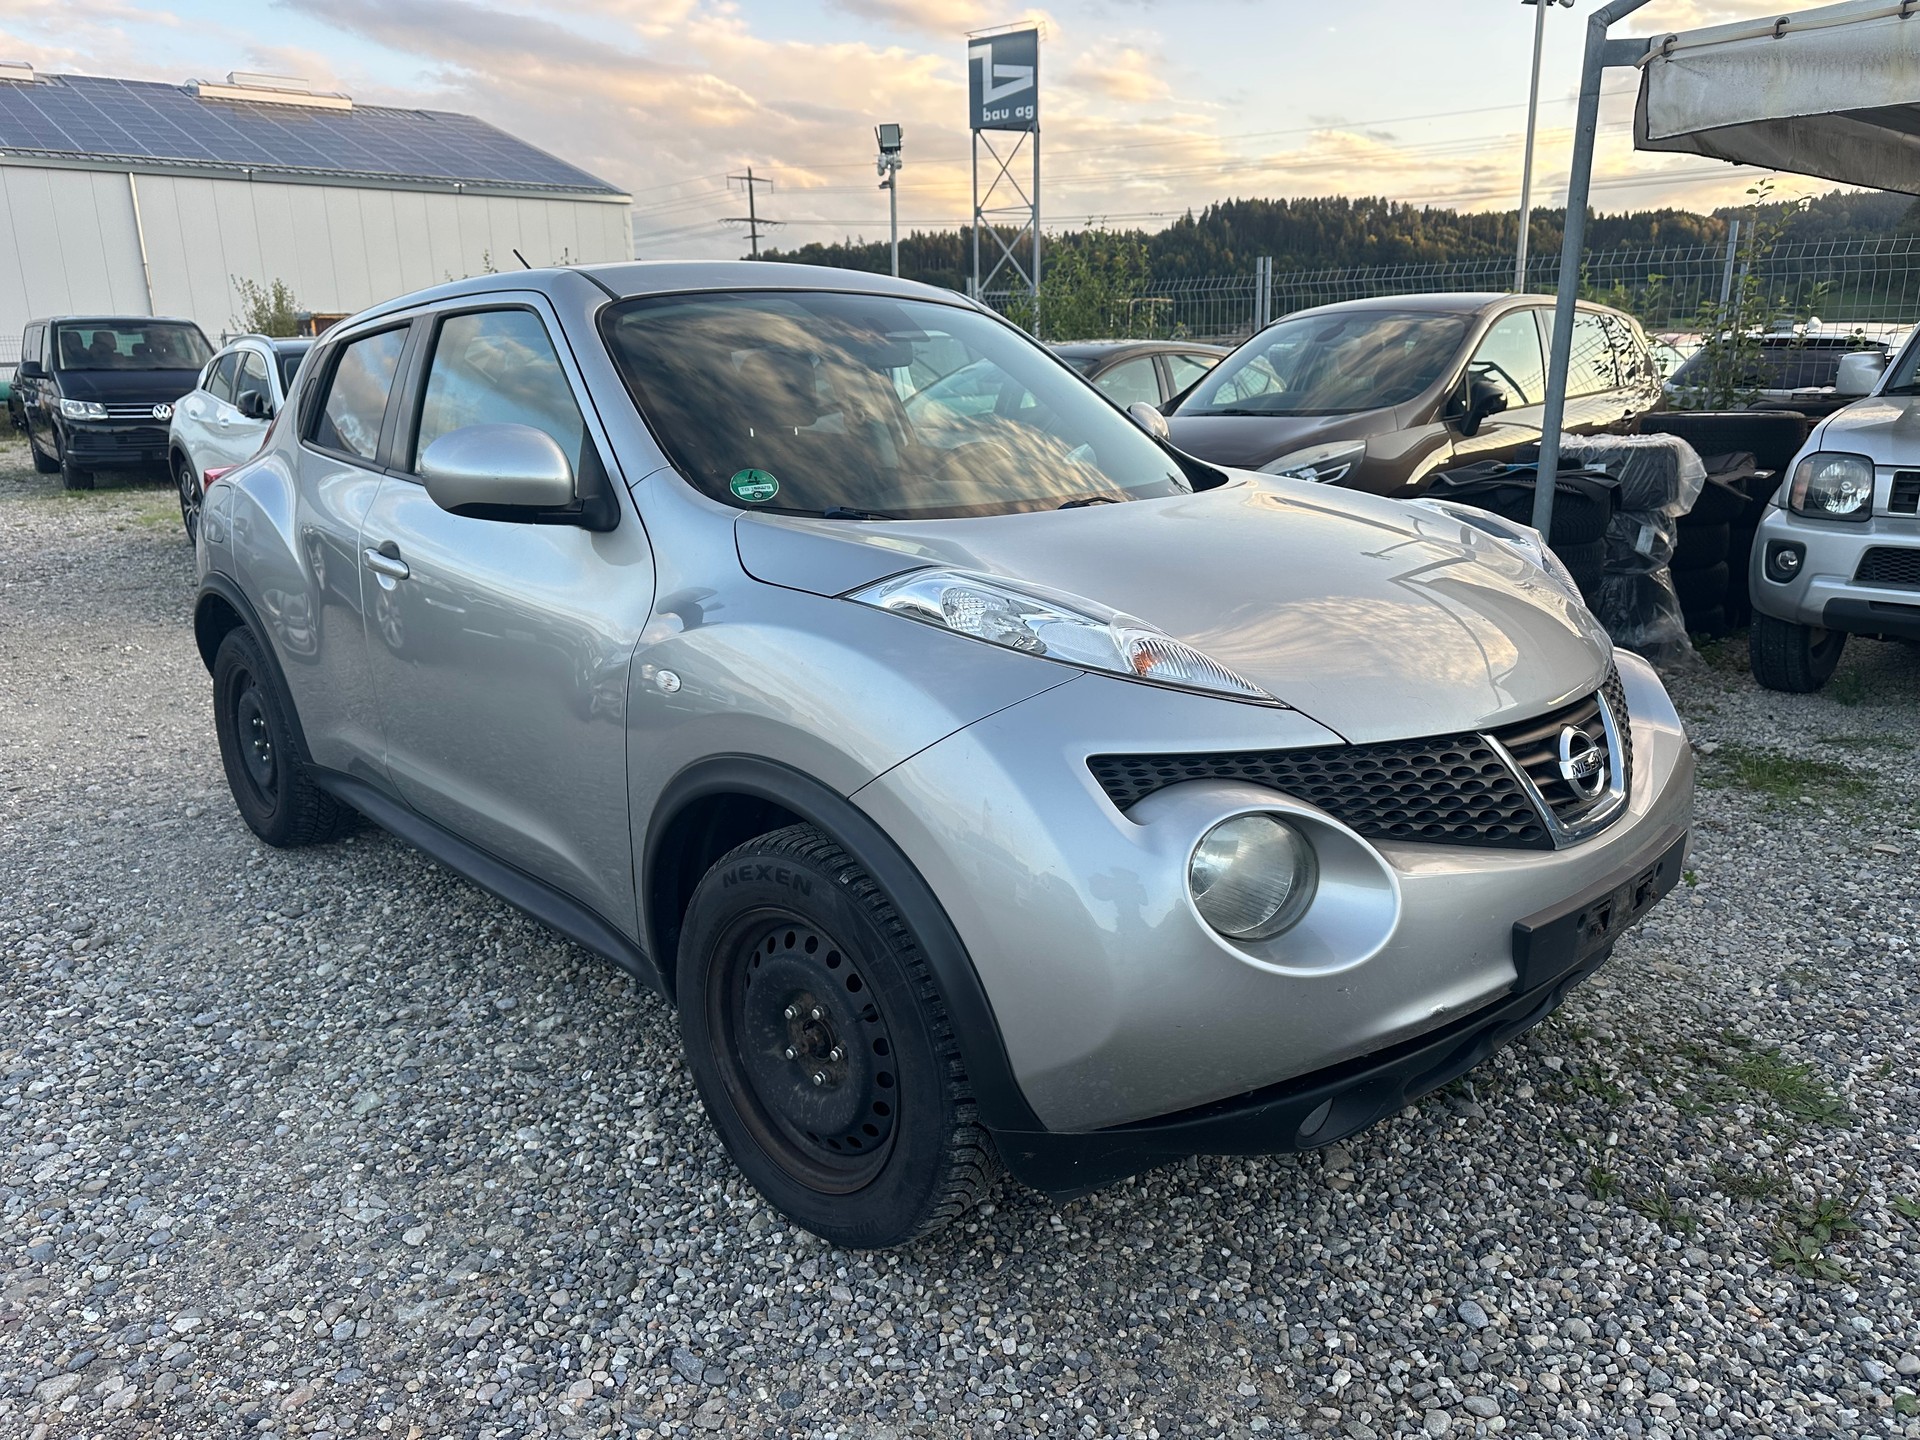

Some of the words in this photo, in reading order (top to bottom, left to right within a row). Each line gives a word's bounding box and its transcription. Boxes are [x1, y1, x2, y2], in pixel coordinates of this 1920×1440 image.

[983, 107, 1010, 122] bau
[1015, 105, 1034, 119] ag
[1571, 754, 1601, 776] NISS
[722, 864, 813, 897] NEXEN
